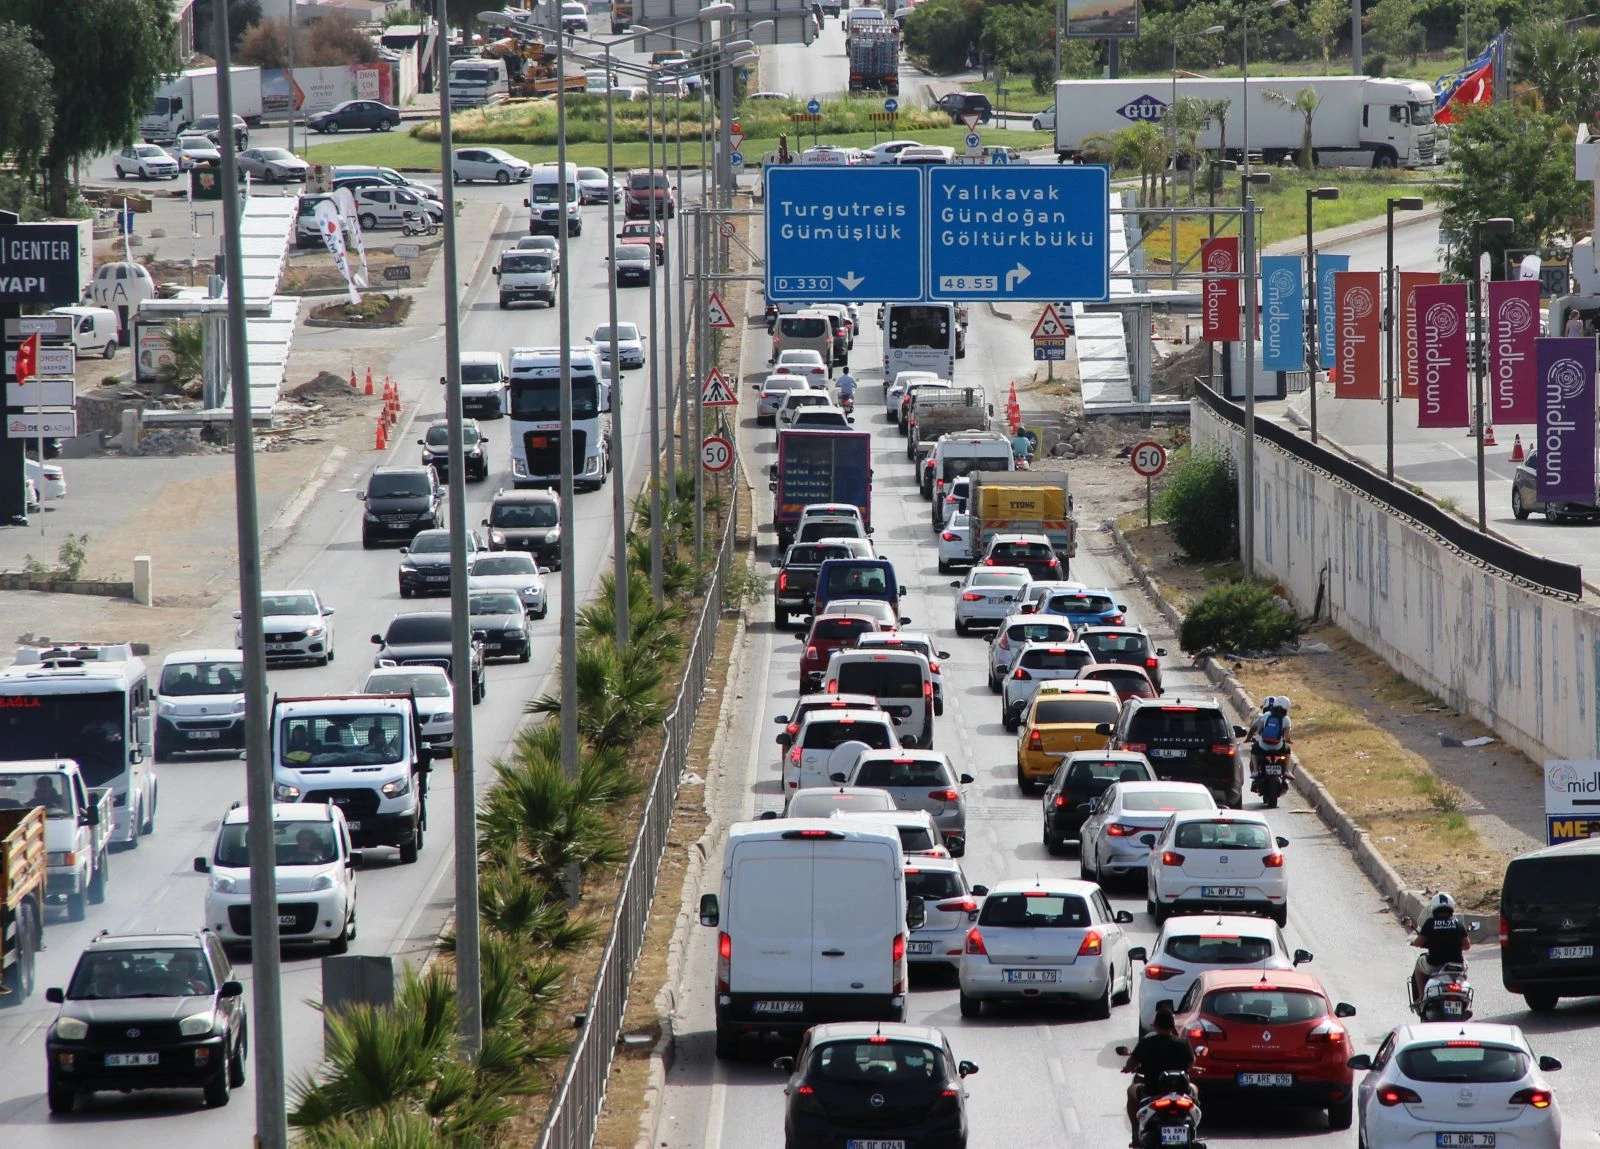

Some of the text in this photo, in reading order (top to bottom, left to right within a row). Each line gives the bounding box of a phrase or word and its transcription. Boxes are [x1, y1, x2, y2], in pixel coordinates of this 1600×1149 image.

[942, 184, 1059, 200] Yalıkavak
[781, 201, 906, 220] Turgutreis
[941, 208, 1065, 226] Gündoğan
[781, 224, 901, 241] Gümüşlük
[941, 230, 1094, 246] Göltürkbükü
[11, 241, 70, 260] CENTER
[0, 277, 46, 292] YAPI
[778, 278, 829, 290] D.330
[944, 278, 994, 289] 48.55
[1269, 287, 1290, 358] midtown
[1343, 306, 1366, 385] midtown
[1425, 325, 1452, 414] midtown
[1498, 320, 1525, 409] midtown
[1546, 384, 1576, 486] midtown
[706, 446, 727, 463] 50
[1138, 450, 1160, 467] 50
[1567, 771, 1600, 793] mid
